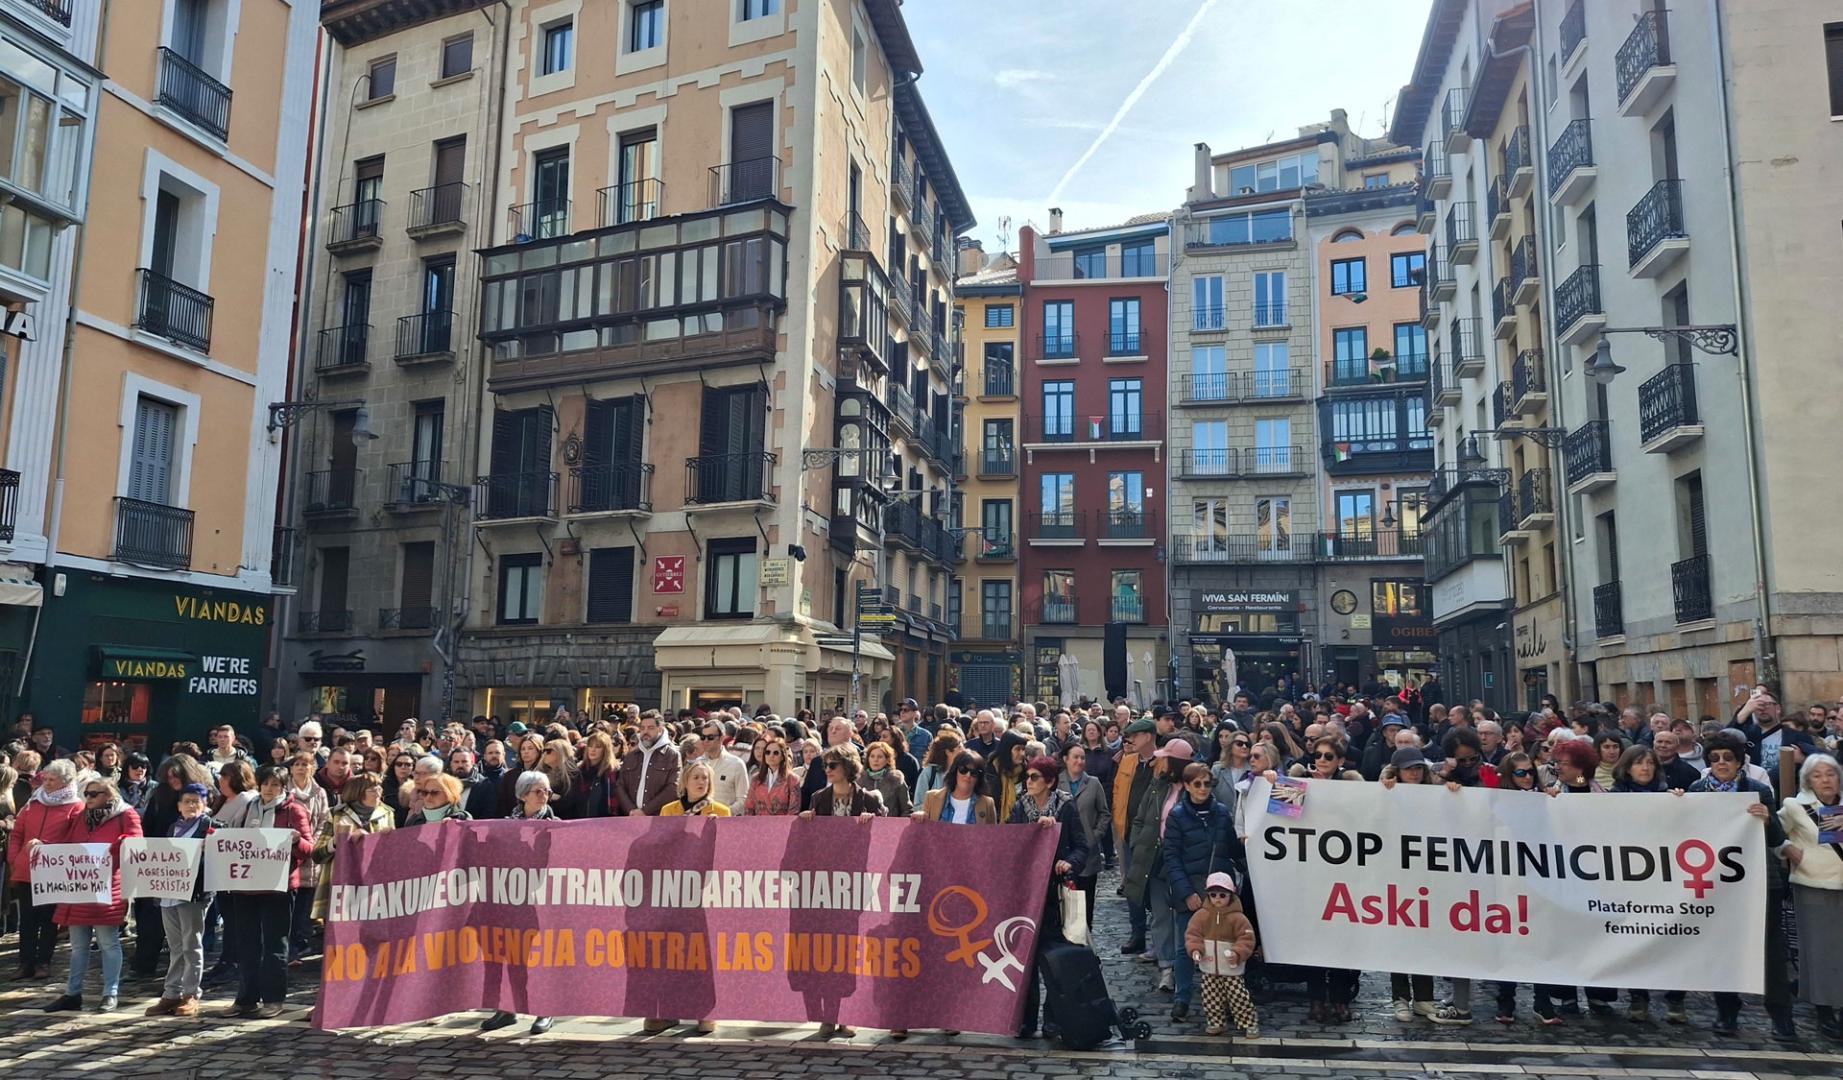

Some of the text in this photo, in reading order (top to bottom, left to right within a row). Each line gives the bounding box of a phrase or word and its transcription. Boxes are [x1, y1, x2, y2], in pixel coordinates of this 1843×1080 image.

[1228, 593, 1248, 603] SAN
[175, 595, 265, 625] VIANDAS
[1341, 629, 1350, 640] 2
[115, 660, 186, 678] VIANDAS
[188, 677, 257, 695] FARMERS
[217, 839, 252, 853] ERASO
[1264, 826, 1383, 867] STOP
[129, 848, 182, 864] NO A LAS
[230, 862, 251, 879] EZ
[33, 882, 44, 895] EL
[328, 866, 921, 922] EMAKUMEON KONTRAKO INDARKERIARIK EZ
[1321, 882, 1529, 936] Aski da!
[1588, 900, 1715, 918] Plataforma Stop
[1605, 921, 1700, 937] feminicidios
[325, 926, 921, 981] NO A LA VIOLENCIA CONTRA LAS MUJERES
